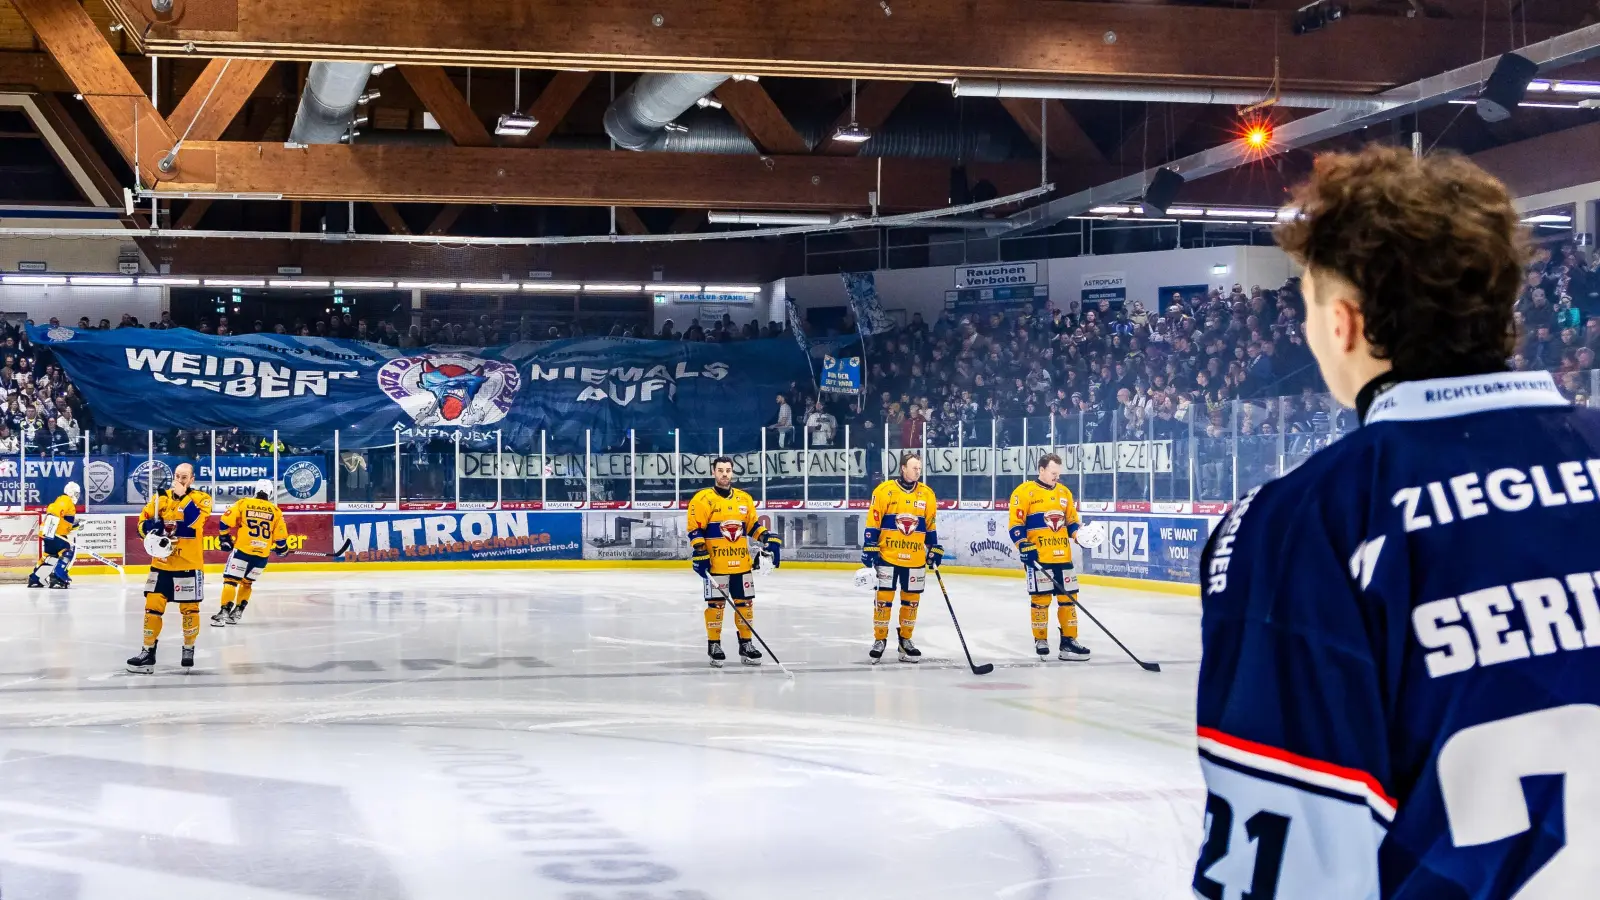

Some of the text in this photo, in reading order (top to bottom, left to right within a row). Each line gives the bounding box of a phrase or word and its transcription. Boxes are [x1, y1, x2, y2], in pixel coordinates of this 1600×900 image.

[966, 266, 1025, 277] Rauchen
[966, 275, 1026, 285] Verboten
[1084, 278, 1123, 286] ASTROPLAST
[531, 361, 730, 385] NIEMALS
[25, 461, 74, 477] EVW
[218, 466, 267, 477] WEIDEN
[596, 453, 650, 476] LEBT
[246, 519, 271, 539] 58
[333, 512, 530, 557] WITRON
[1160, 527, 1198, 541] WE WANT
[344, 532, 551, 562] Deine Karrierechance
[471, 541, 579, 558] www.witron-karriere.de
[597, 549, 627, 558] Kreative
[969, 538, 1013, 557] Kondrauer
[1168, 546, 1189, 559] YOU!
